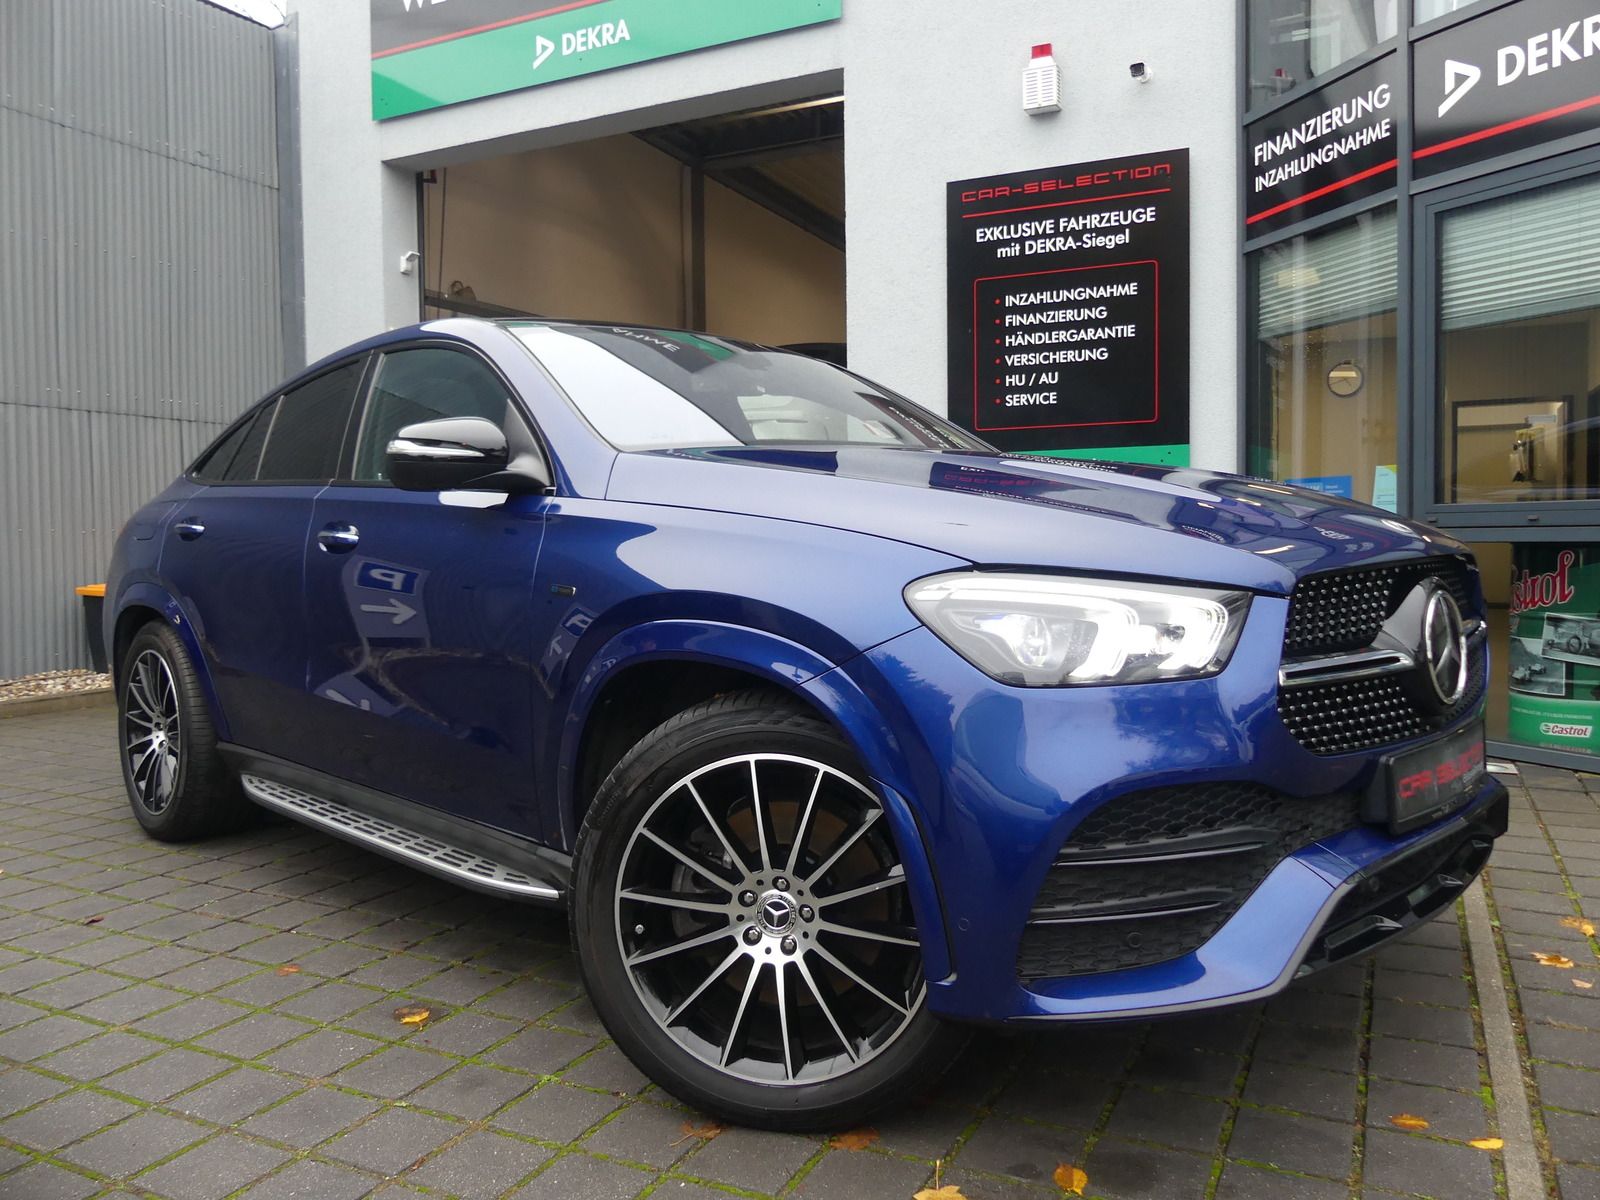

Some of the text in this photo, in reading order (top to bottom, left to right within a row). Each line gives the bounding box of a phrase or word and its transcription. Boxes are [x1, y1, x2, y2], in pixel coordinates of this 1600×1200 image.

[561, 19, 631, 56] DEKRA
[1254, 83, 1391, 166] FINANZIERUNG
[1255, 118, 1391, 193] INZAHLUNGNAHME
[961, 163, 1171, 203] CAR-SELECTION
[975, 207, 1156, 243] EXKLUSIVE FAHRZEUGE
[996, 228, 1130, 259] mit DEKRA-Siegel
[1004, 282, 1138, 307] INZAHLUNGNAHME
[1004, 306, 1108, 327] FINANZIERUNG
[1004, 325, 1136, 347] HÄNDLERGARANTIE
[1004, 348, 1109, 367] VERSICHERUNG
[1005, 371, 1059, 387] HU / AU
[1004, 392, 1057, 407] SERVICE
[1510, 550, 1574, 614] strol
[1551, 724, 1589, 736] Castrol
